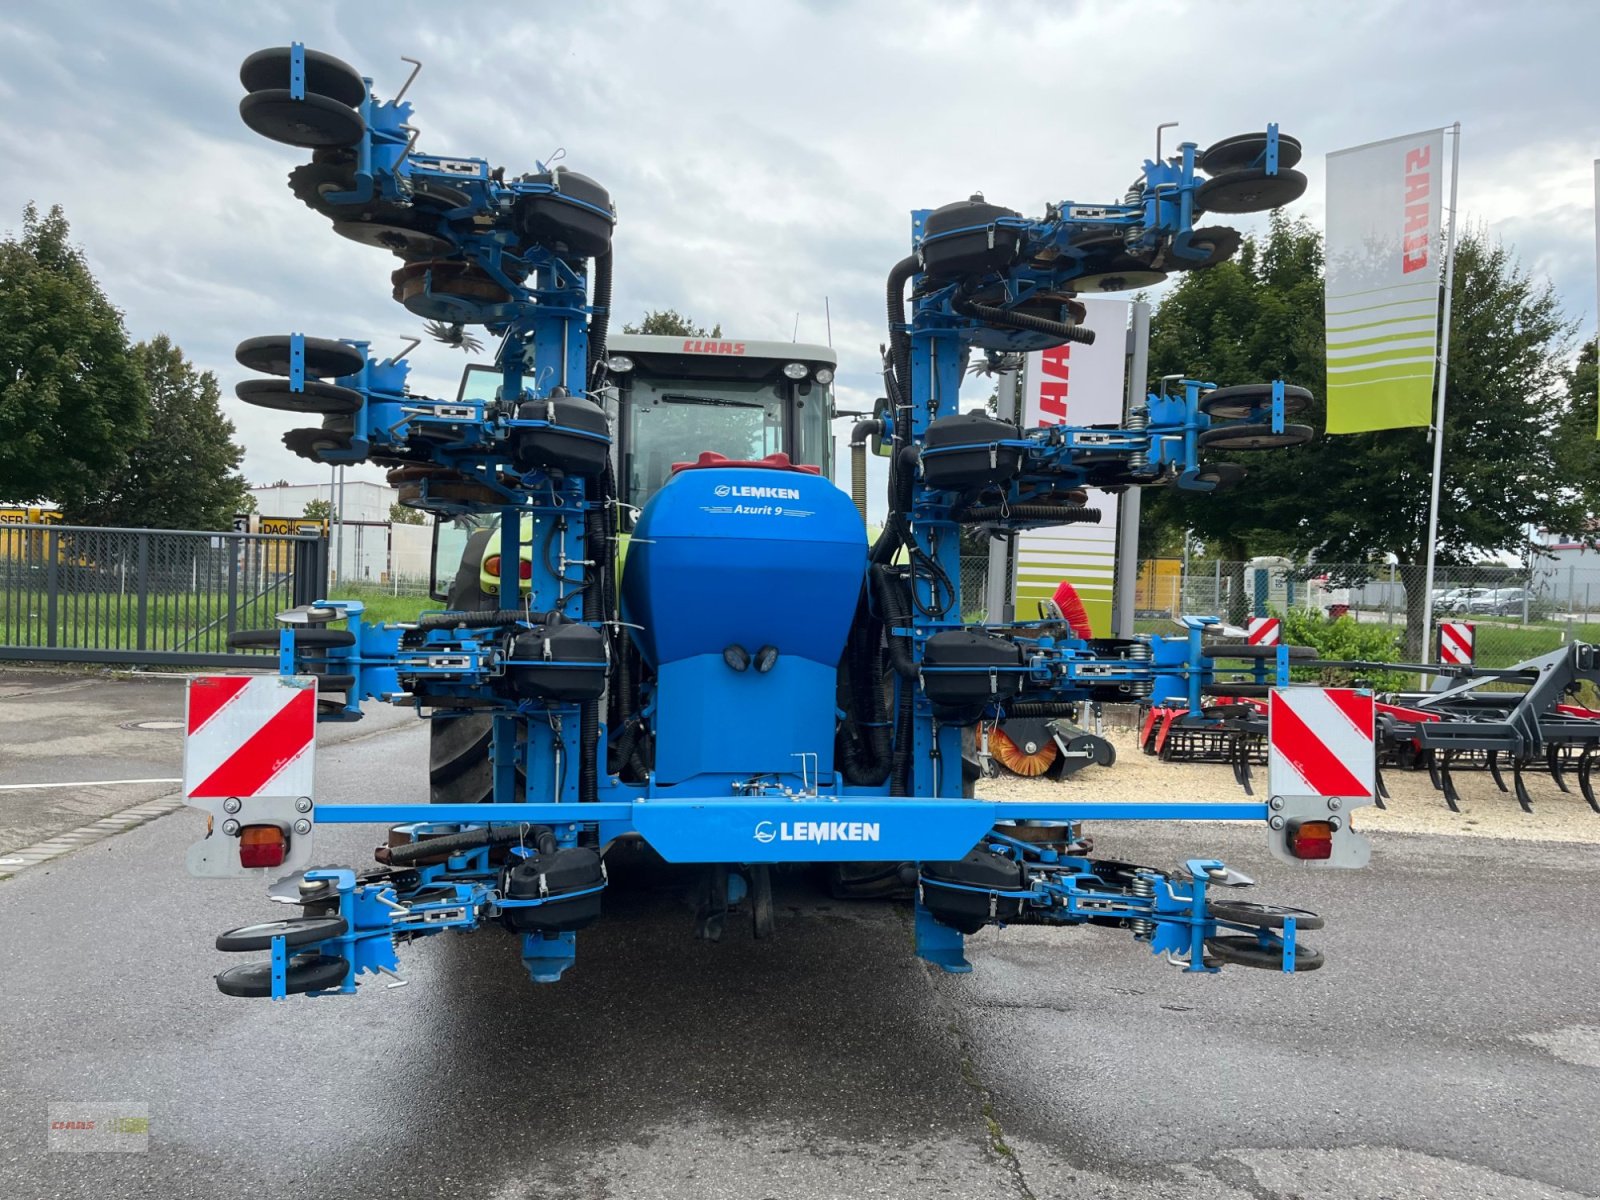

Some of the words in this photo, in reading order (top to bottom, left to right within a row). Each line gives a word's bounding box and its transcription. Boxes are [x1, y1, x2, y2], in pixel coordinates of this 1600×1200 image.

[682, 340, 746, 355] CLAAS
[731, 485, 800, 500] LEMKEN
[734, 504, 773, 516] Azurit
[773, 506, 784, 517] 9
[0, 514, 24, 525] SER
[263, 523, 302, 536] DACHS
[780, 821, 881, 845] LEMKEN
